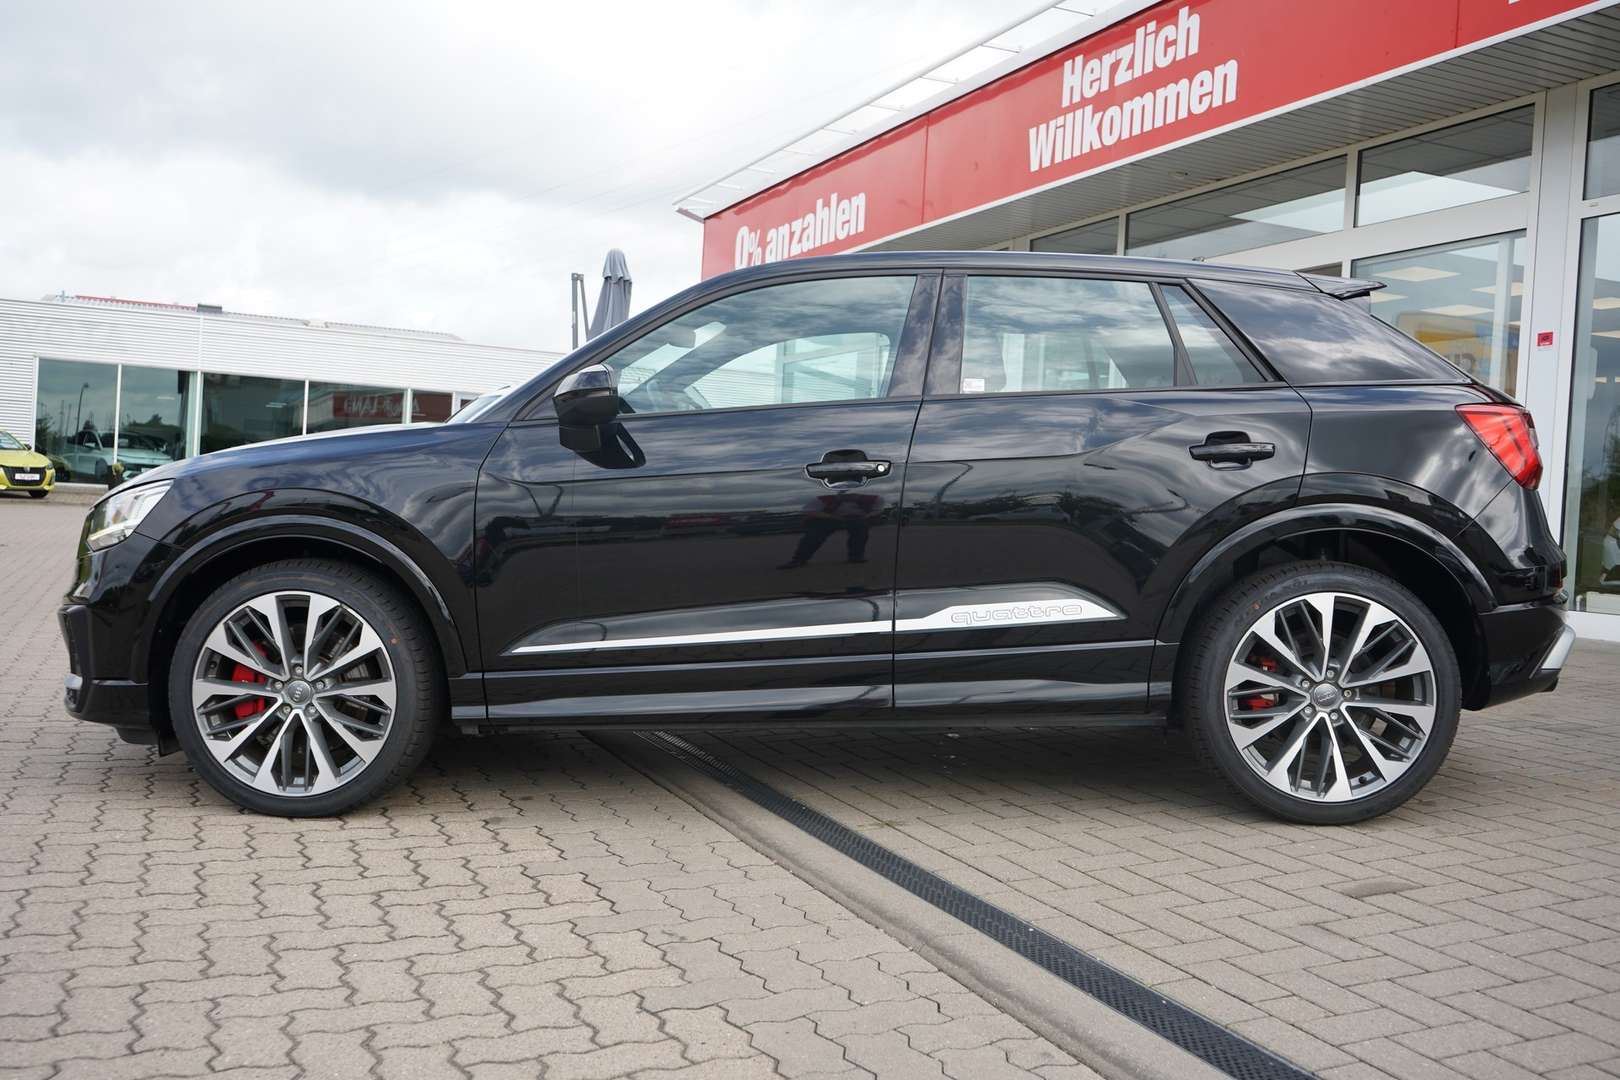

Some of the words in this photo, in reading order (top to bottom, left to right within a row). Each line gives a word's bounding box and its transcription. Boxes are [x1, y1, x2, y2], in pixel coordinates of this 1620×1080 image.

[1061, 6, 1200, 108] Herzlich
[1029, 59, 1238, 172] Willkommen
[735, 226, 762, 270] 0%
[765, 192, 866, 263] anzahlen
[951, 604, 1082, 625] quattro
